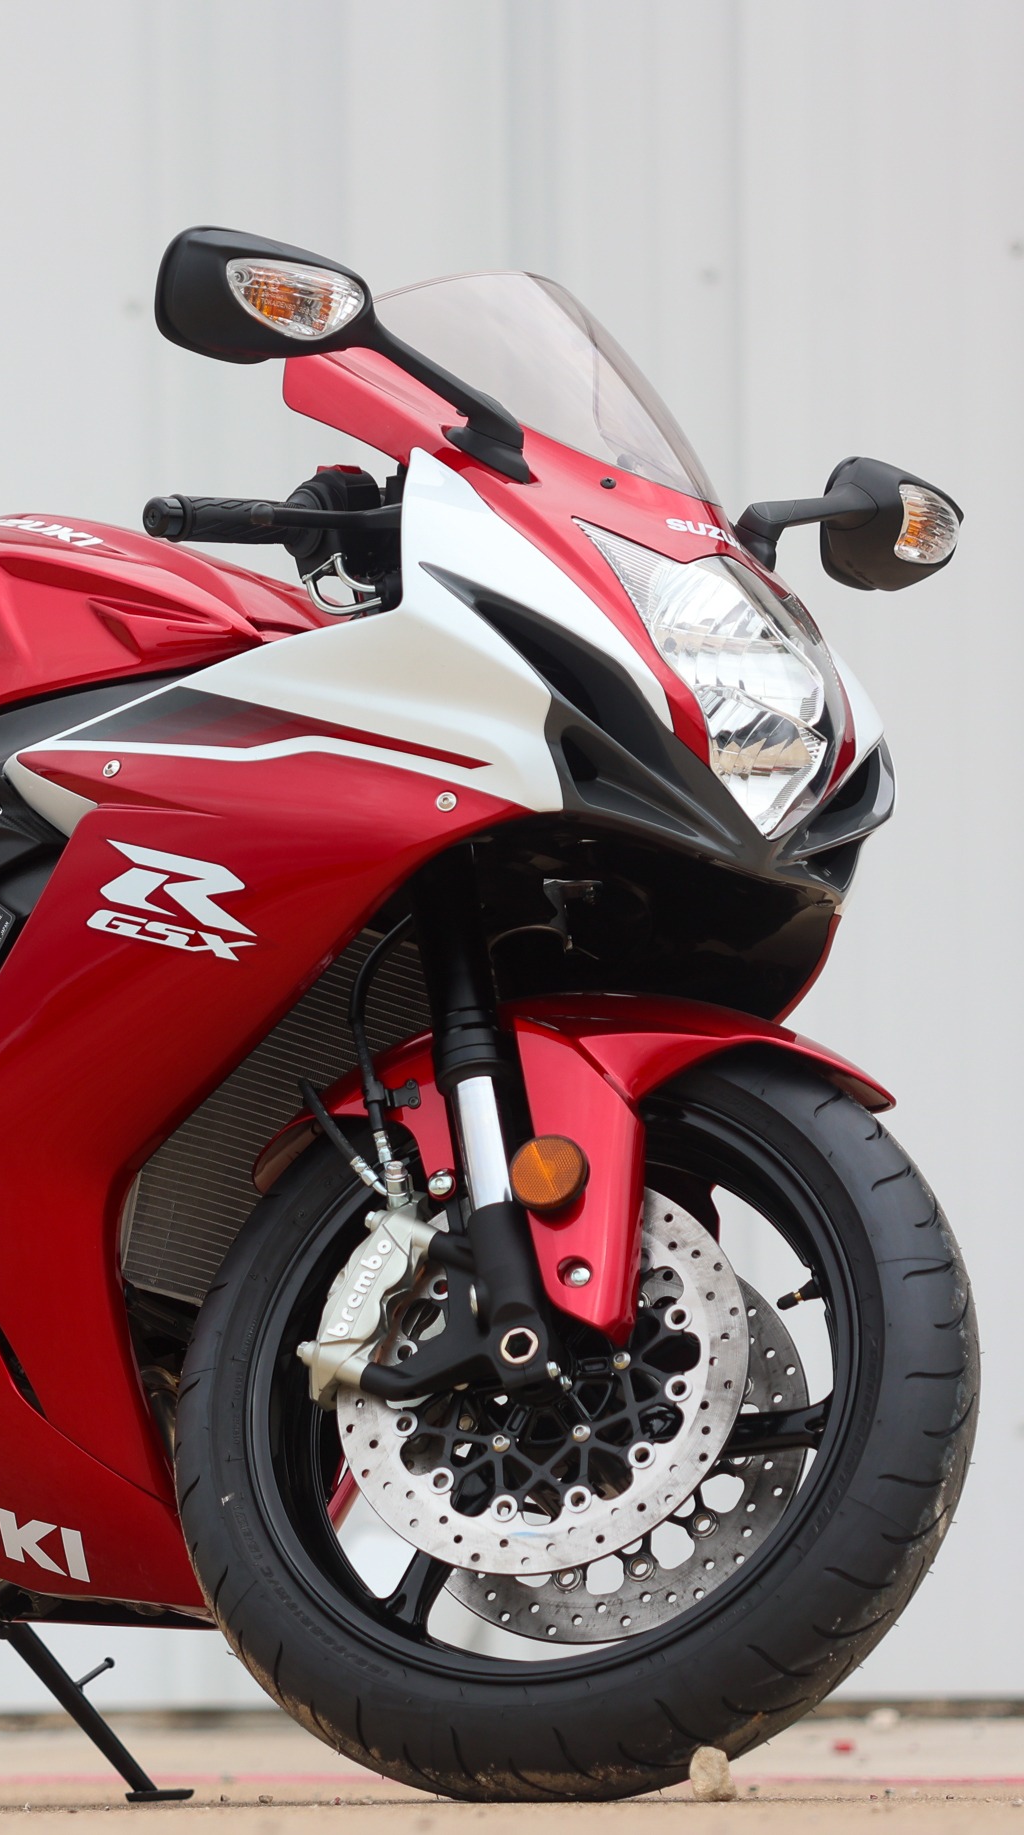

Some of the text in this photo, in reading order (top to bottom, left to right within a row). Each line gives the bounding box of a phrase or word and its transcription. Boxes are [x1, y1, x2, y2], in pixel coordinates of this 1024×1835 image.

[86, 909, 257, 961] GSX
[100, 839, 257, 936] R
[327, 1239, 392, 1337] brembo
